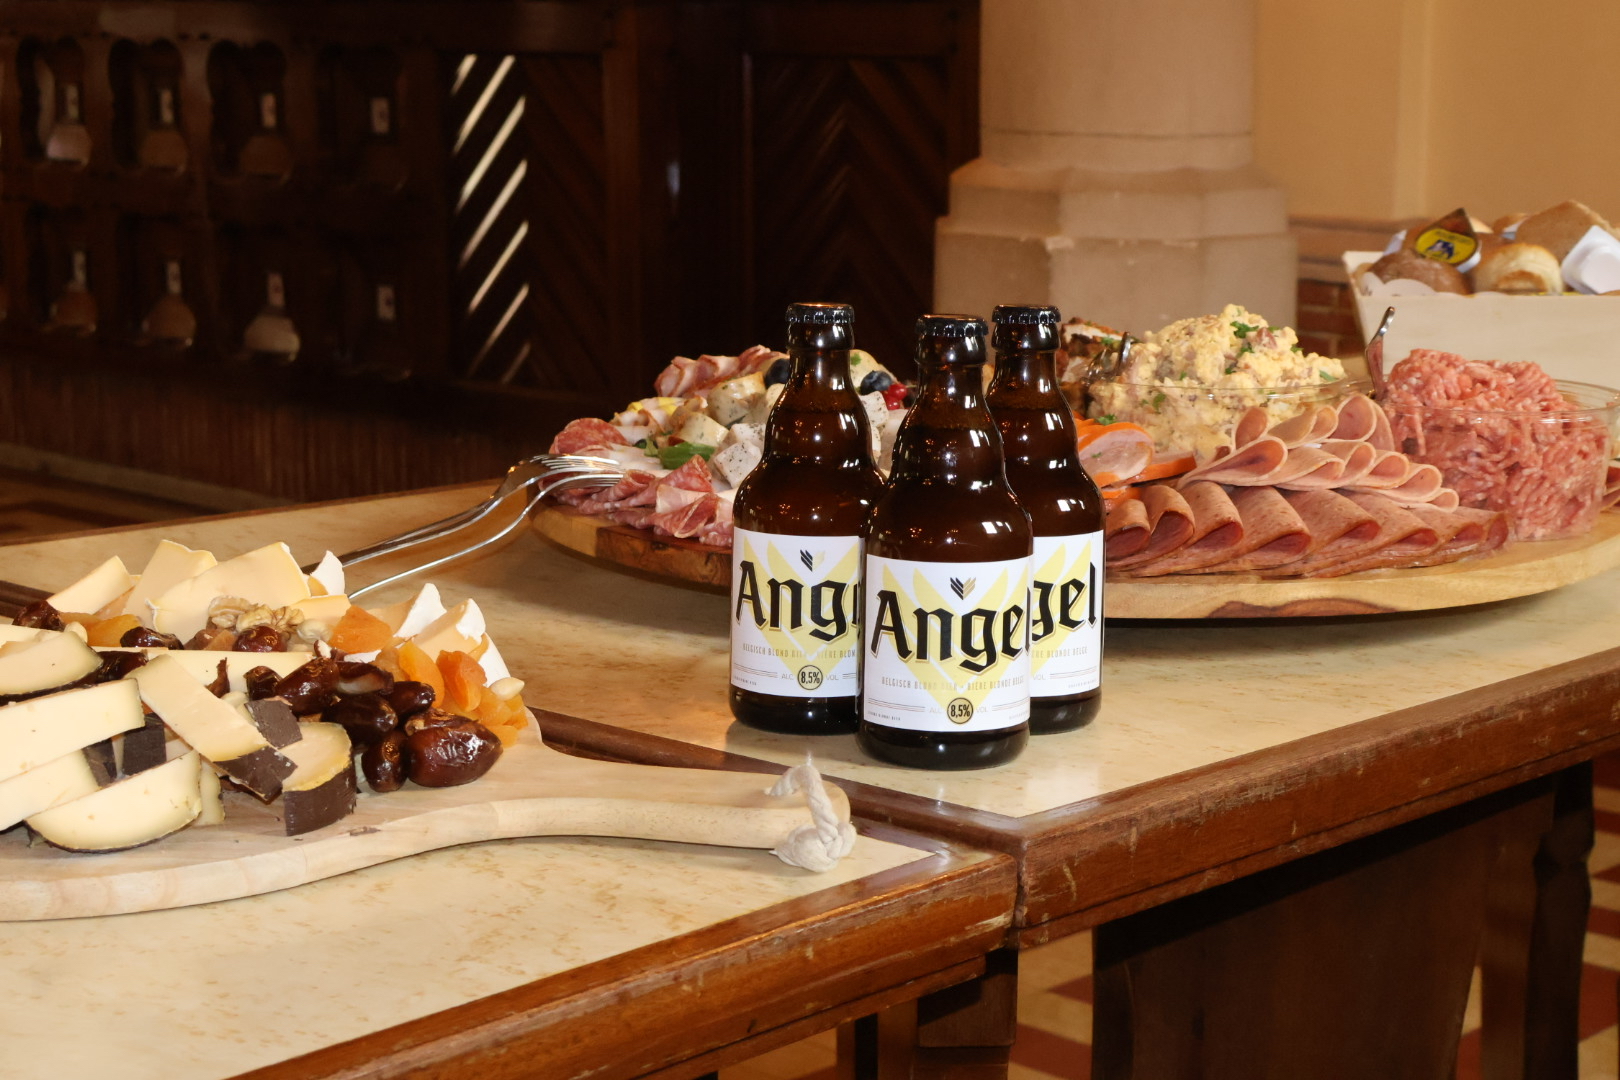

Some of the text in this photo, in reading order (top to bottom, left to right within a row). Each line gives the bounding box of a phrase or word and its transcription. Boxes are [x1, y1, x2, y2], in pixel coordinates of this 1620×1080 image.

[735, 559, 858, 643] Ang
[871, 589, 1032, 675] Angel
[1032, 561, 1098, 643] gel
[881, 676, 911, 688] BELGISCH
[989, 677, 1011, 689] BLONDE
